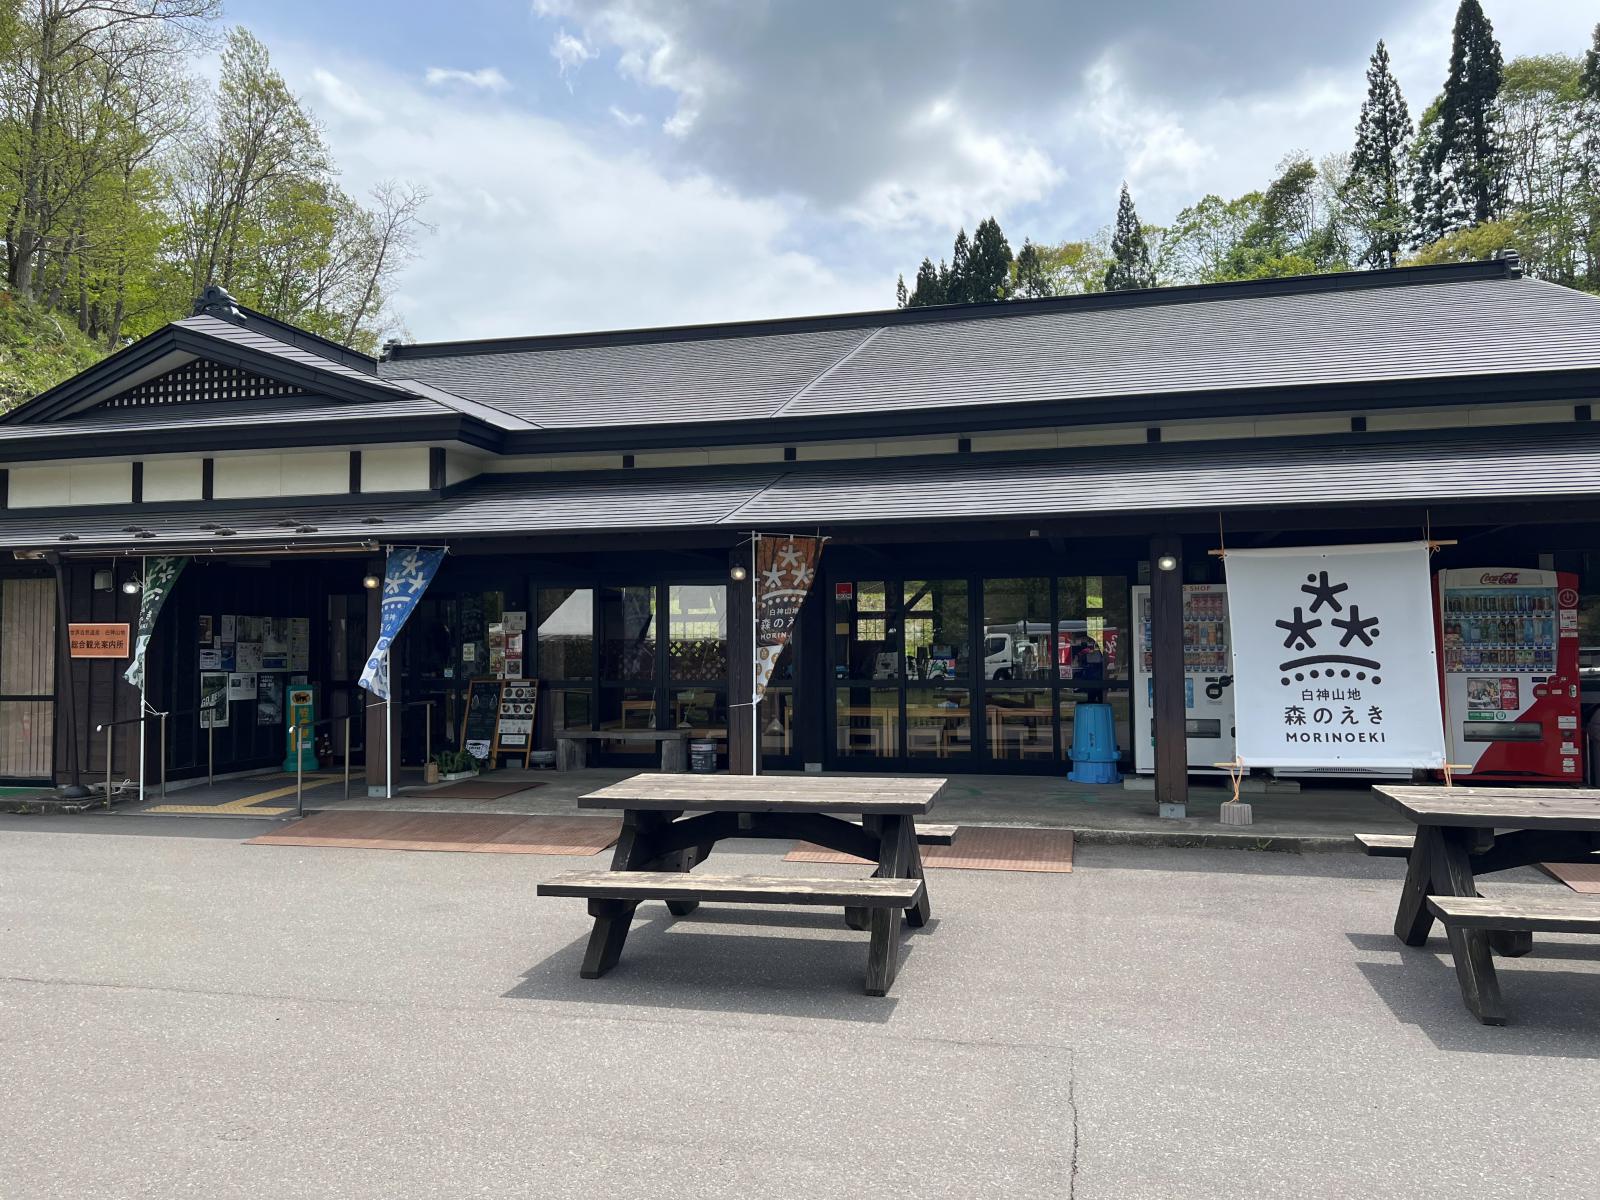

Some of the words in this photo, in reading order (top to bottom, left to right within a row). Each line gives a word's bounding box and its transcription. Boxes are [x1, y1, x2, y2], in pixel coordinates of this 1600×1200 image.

[71, 640, 124, 649] 総合観光案内所
[1302, 688, 1361, 701] 白神山地
[1284, 705, 1383, 726] 森のえき
[1286, 732, 1386, 743] MORINOEKI
